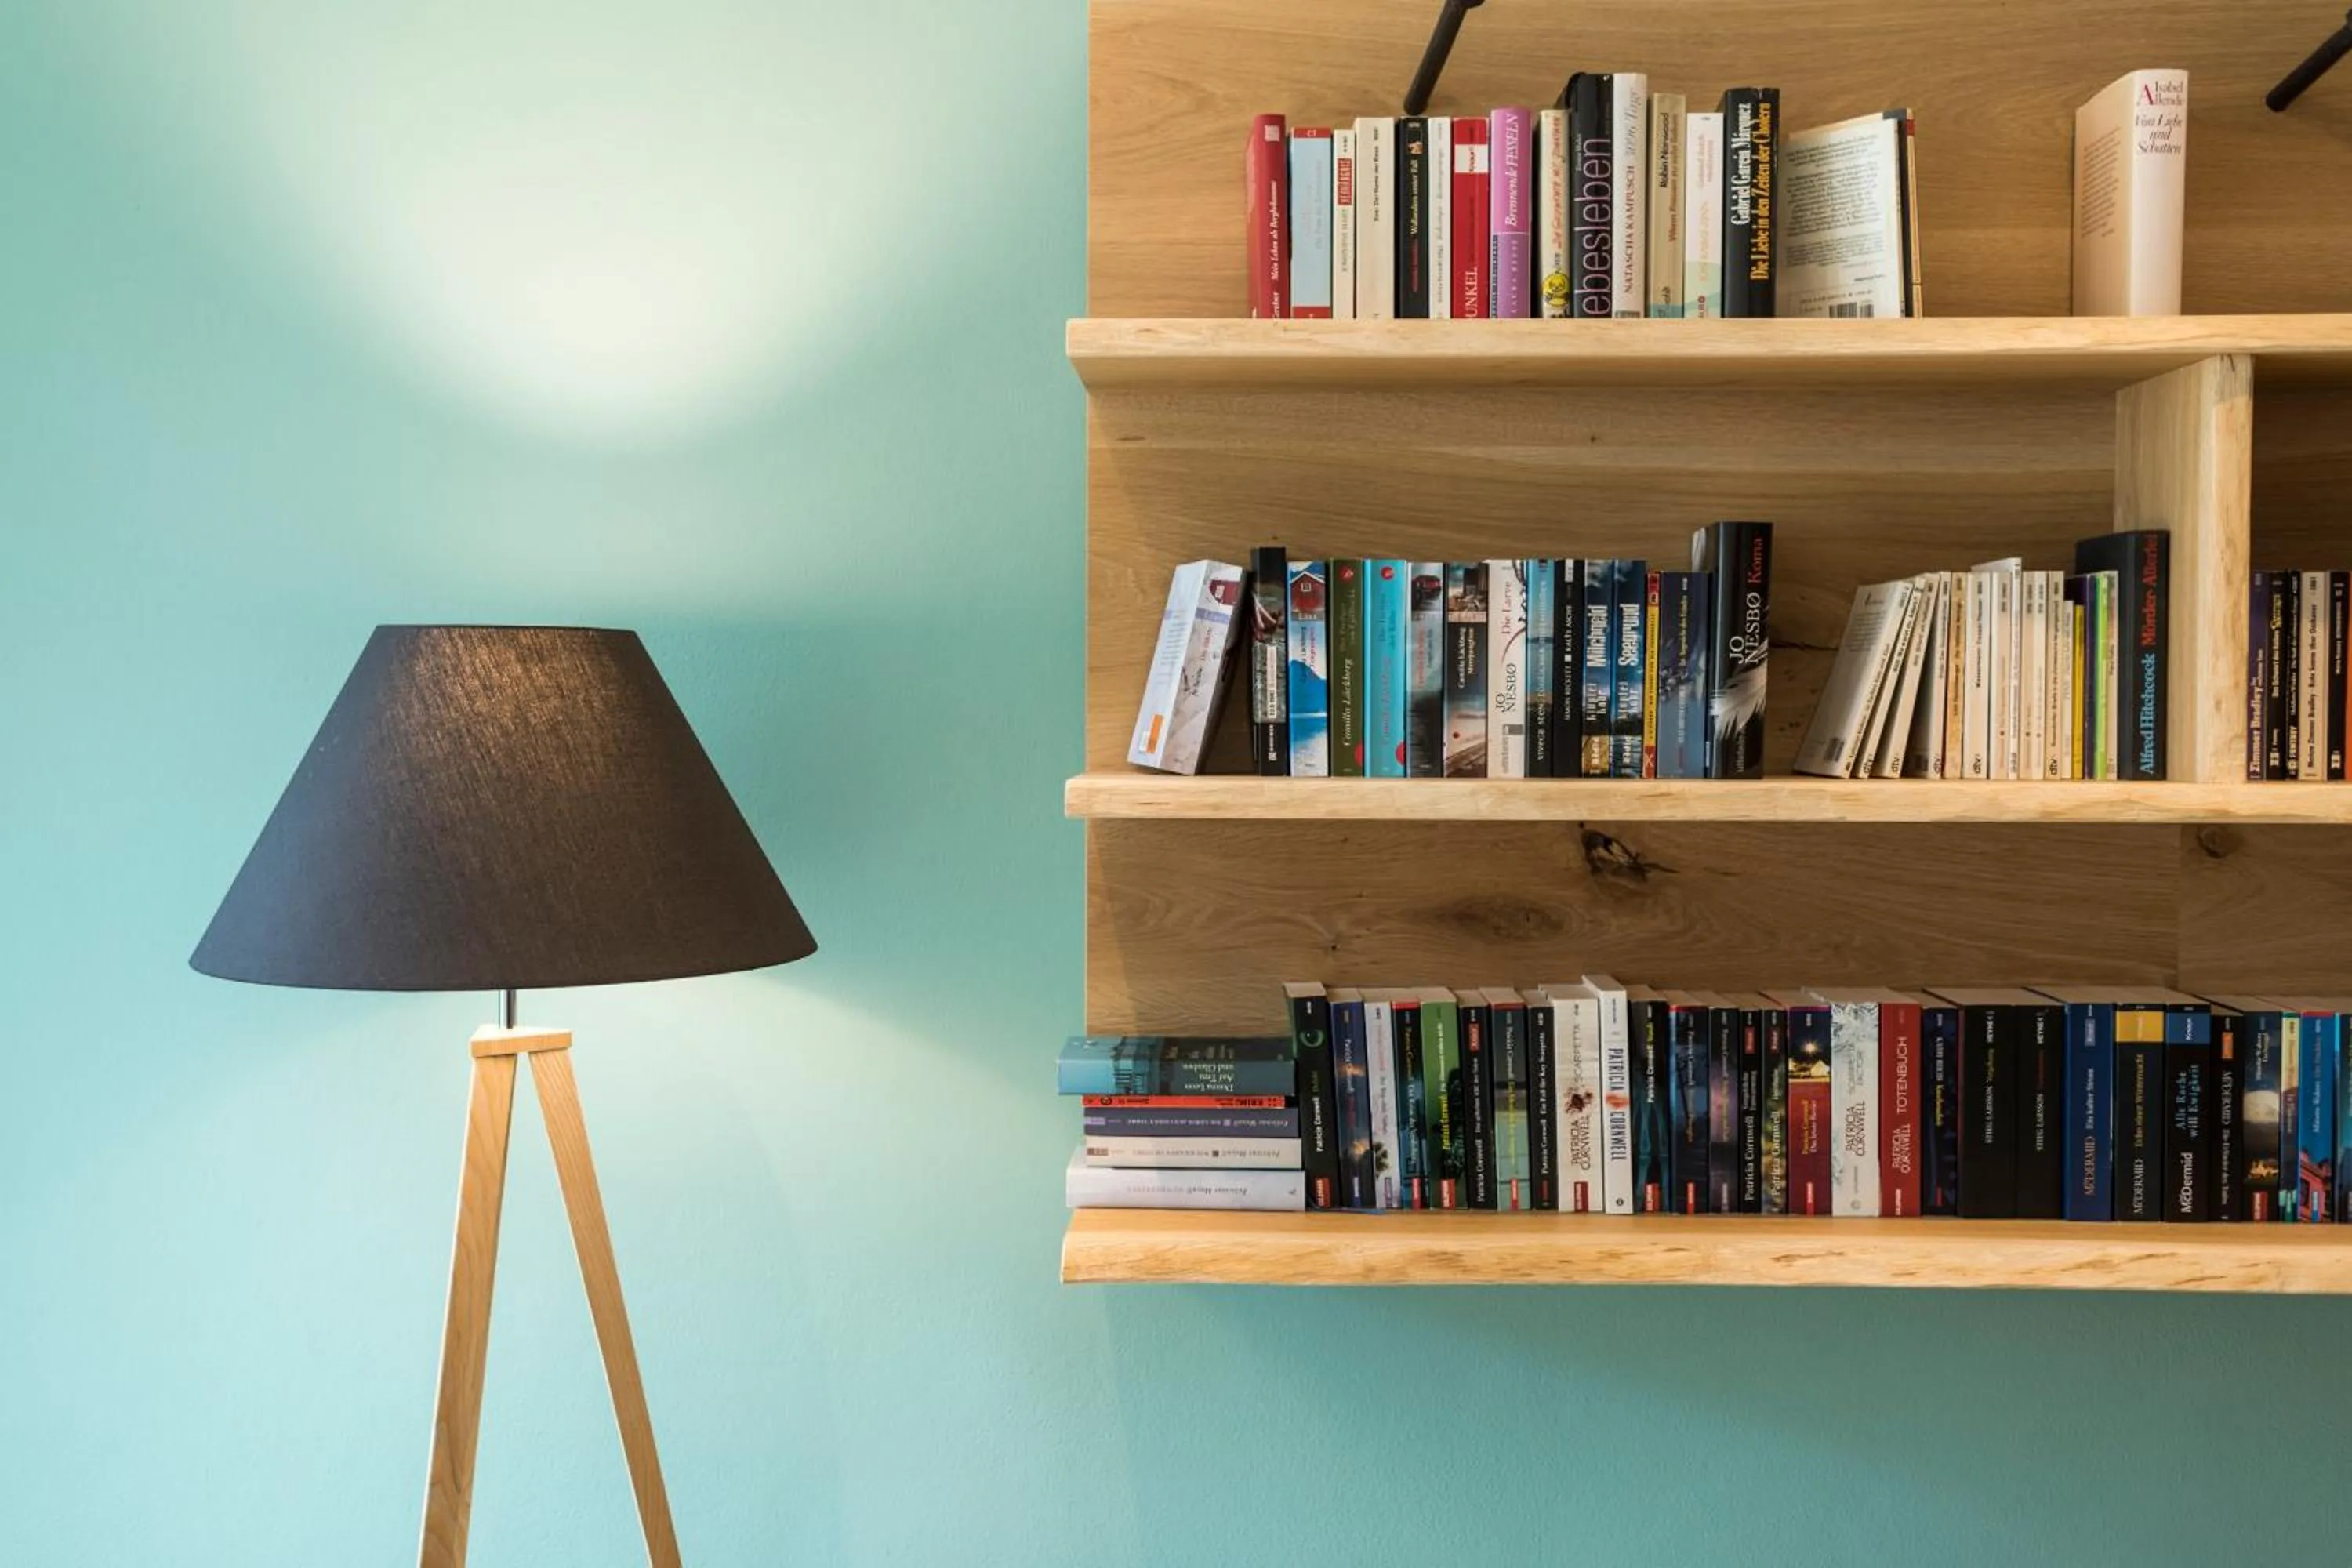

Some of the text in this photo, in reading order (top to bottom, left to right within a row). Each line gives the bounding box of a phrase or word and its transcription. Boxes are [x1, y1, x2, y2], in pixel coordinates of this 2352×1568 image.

[2154, 81, 2184, 93] Isabel
[1658, 111, 1670, 188] Robin Norwood
[1753, 144, 1769, 162] der
[2138, 140, 2182, 154] Schatten
[1504, 169, 1519, 226] Brennende
[1751, 164, 1770, 197] Zeiten
[1730, 186, 1751, 224] Gabriel
[1753, 198, 1769, 217] den
[1753, 218, 1769, 228] in
[1624, 165, 1635, 293] NATASCHA KAMPUSCH
[1751, 230, 1769, 260] Liebe
[1750, 260, 1769, 279] Die
[1747, 537, 1764, 584] Koma
[1501, 581, 1512, 635] Die Larve
[1744, 591, 1762, 664] NESBØ
[1585, 604, 1608, 667] Milchgeld
[1617, 603, 1640, 666] Seegrund
[1729, 635, 1746, 665] JO
[1457, 660, 1467, 688] Camilla
[1505, 662, 1518, 712] NESBØ
[1340, 658, 1355, 746] Camilla Läckberg
[1495, 692, 1507, 713] JO
[2137, 652, 2156, 775] Alfred Hitchcock
[2249, 686, 2264, 728] Bradley
[1535, 703, 1545, 760] viveca sten
[1890, 753, 1901, 774] dtv
[1932, 753, 1941, 774] dtv
[1973, 754, 1982, 775] dtv
[2049, 754, 2059, 775] dtv
[1571, 1023, 1583, 1083] SCARPETTA
[2036, 1021, 2045, 1044] HEYNE
[1182, 1062, 1234, 1073] und Glauben
[1199, 1073, 1234, 1083] Auf Treu
[1207, 1083, 1234, 1094] Donna
[1607, 1047, 1626, 1091] PATRICIA
[1646, 1044, 1655, 1104] Patricia Cornwell
[1896, 1036, 1909, 1115] TOTENBUCH
[1312, 1096, 1322, 1125] Cornwell
[1439, 1094, 1451, 1151] Patricia Cornwell
[1984, 1086, 1994, 1144] STIEG LARSSON
[2035, 1094, 2045, 1128] LARSSON
[2085, 1116, 2094, 1130] Ein
[2176, 1071, 2187, 1131] Alle Rache
[2187, 1064, 2201, 1138] will Ewigkeit
[1315, 1126, 1324, 1152] Patricia
[1539, 1119, 1550, 1174] Patricia Cornwell
[1570, 1120, 1581, 1165] PATRICIA
[1578, 1114, 1592, 1171] CORNWELL
[1610, 1111, 1628, 1162] CORNWELL
[1769, 1111, 1781, 1157] Cornwell
[1801, 1099, 1810, 1155] Patricia Cornwell
[1845, 1105, 1857, 1152] PATRICIA
[1854, 1100, 1867, 1157] CORNWELL
[1891, 1127, 1902, 1169] PATRICIA
[1900, 1123, 1912, 1174] CORNWELL
[1474, 1139, 1487, 1202] Patricia Cornwell
[1743, 1116, 1755, 1201] Patricia Cornwell
[1769, 1157, 1782, 1197] Patricia
[2083, 1136, 2096, 1196] McDERMID
[2132, 1159, 2144, 1214] McDERMID
[2178, 1152, 2194, 1214] McDermid
